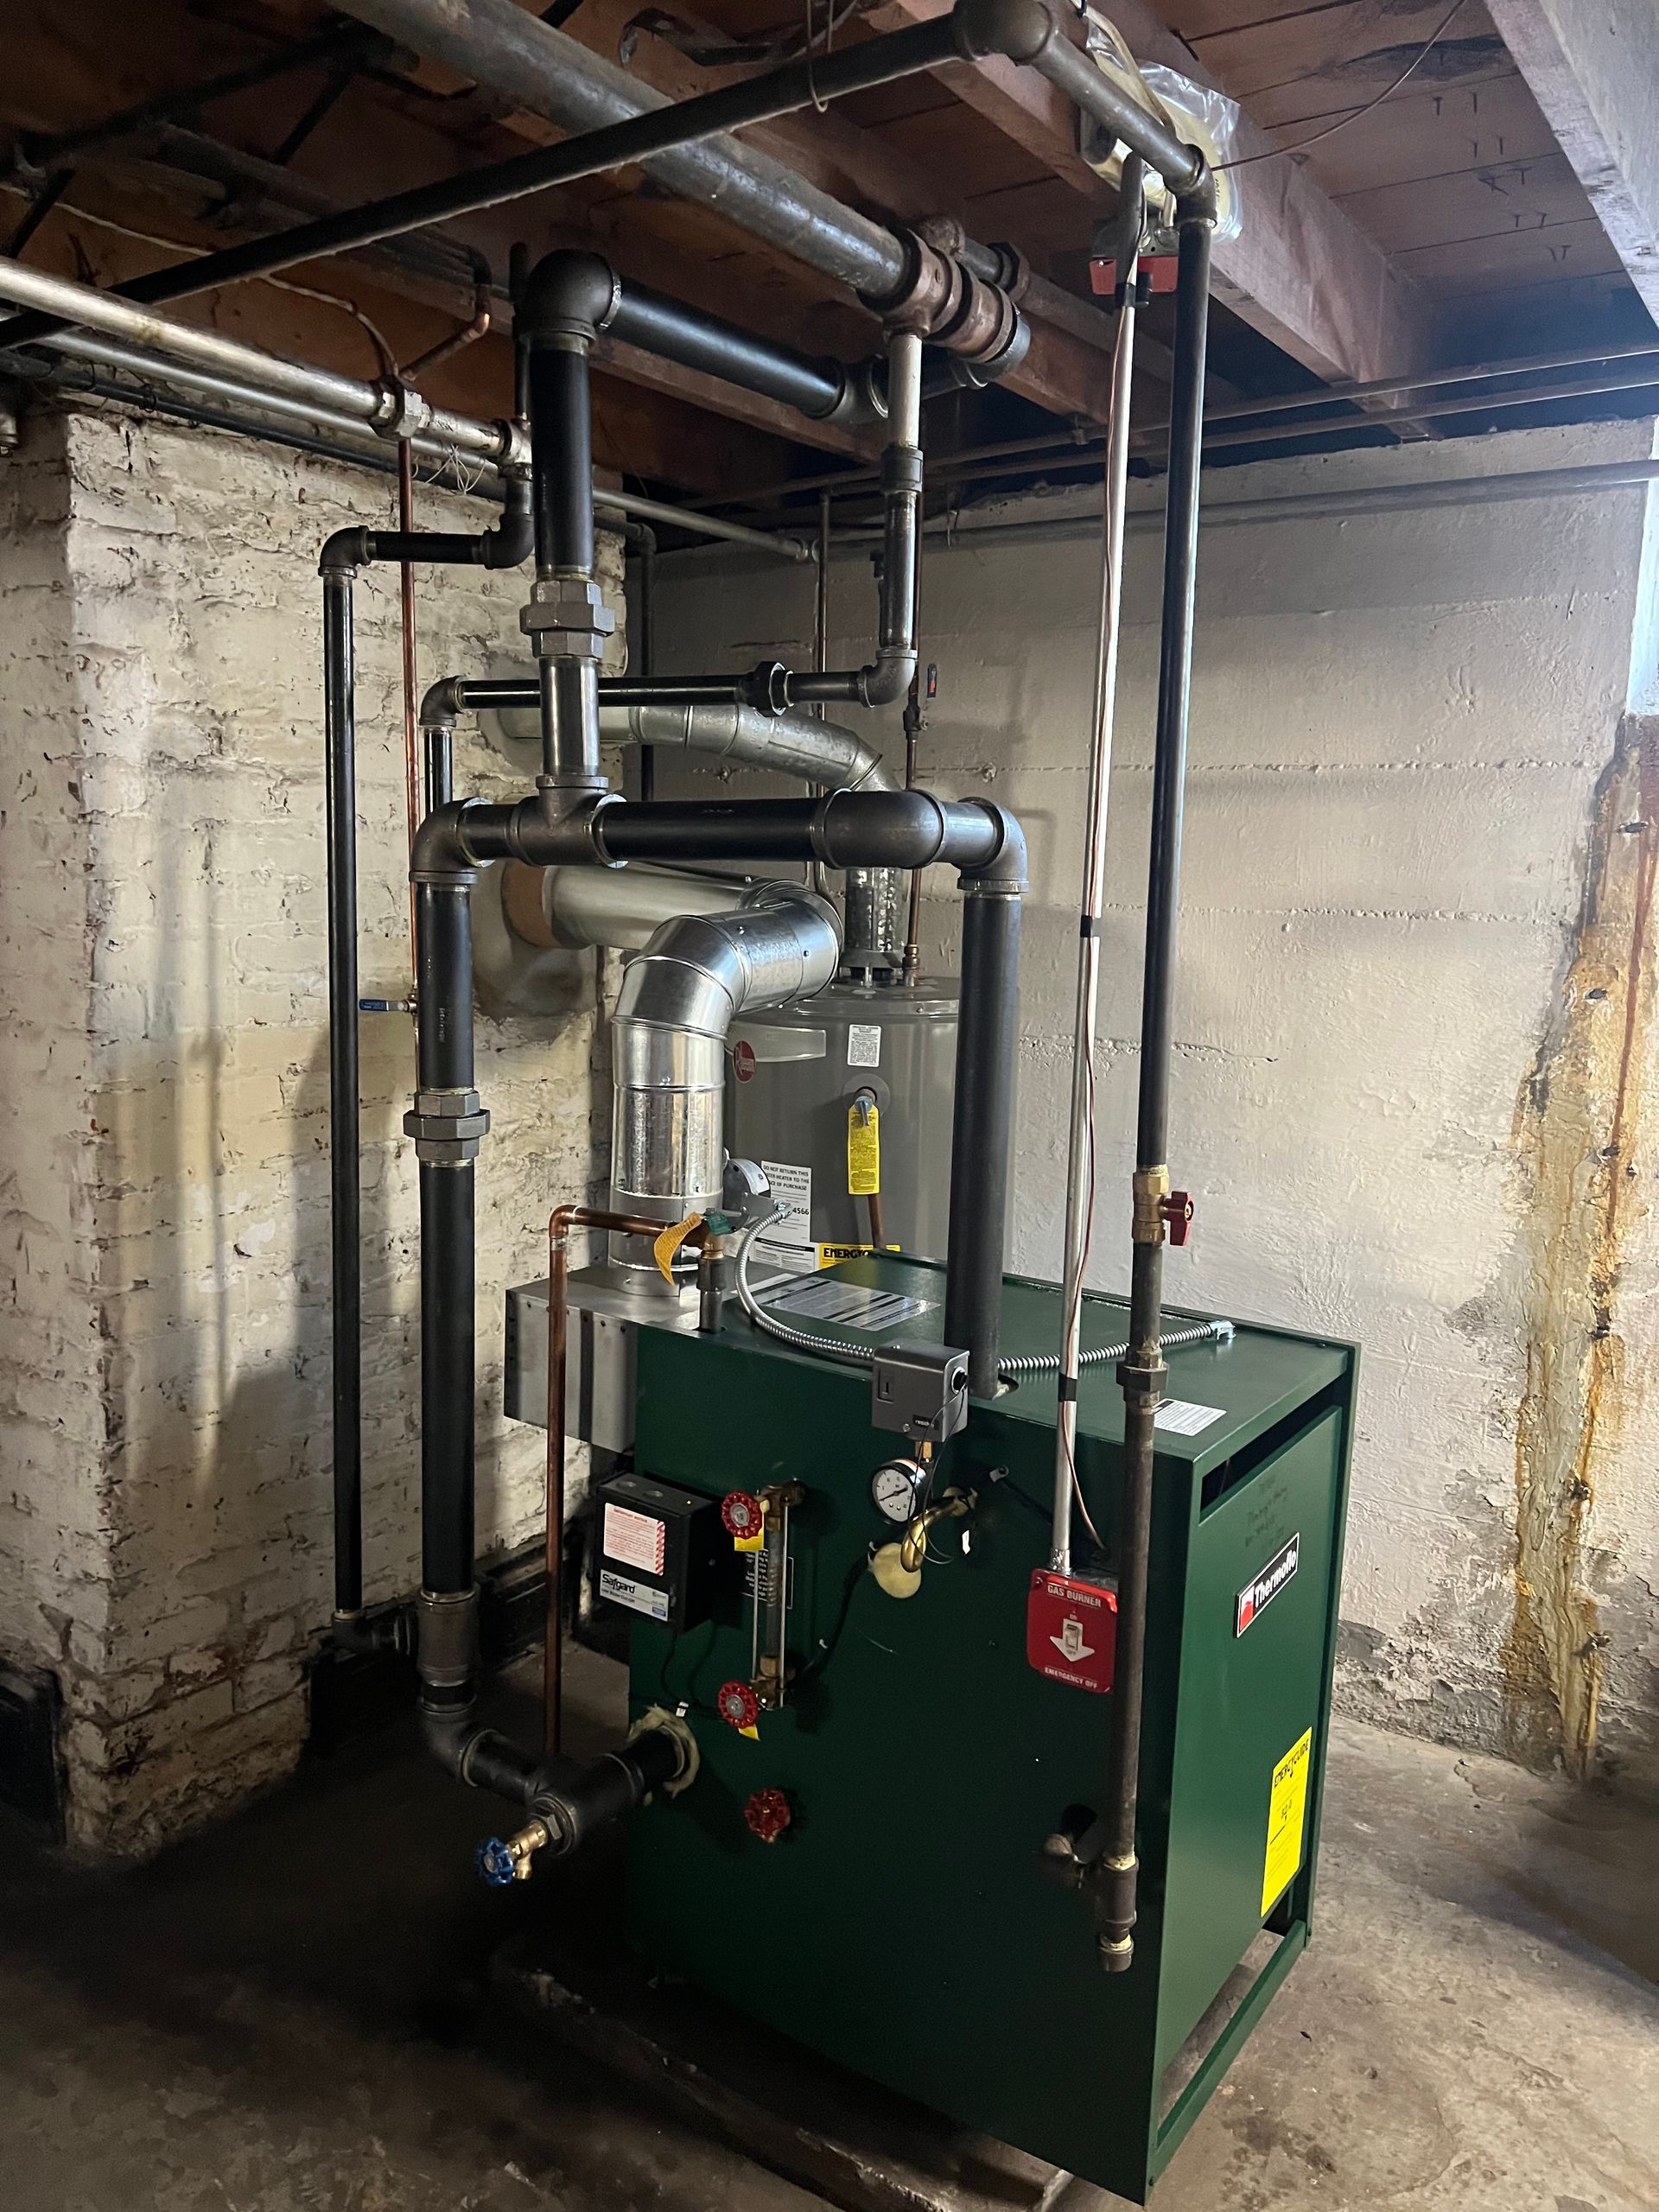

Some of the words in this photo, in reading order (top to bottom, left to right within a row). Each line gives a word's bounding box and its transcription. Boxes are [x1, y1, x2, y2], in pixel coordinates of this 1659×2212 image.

[602, 1573, 636, 1594] Safgard
[1254, 1549, 1297, 1608] Thermoflo
[1047, 1585, 1065, 1597] GAS
[1066, 1590, 1101, 1608] BURNER
[1045, 1667, 1084, 1685] EMERGENCY
[1084, 1680, 1097, 1689] OFF
